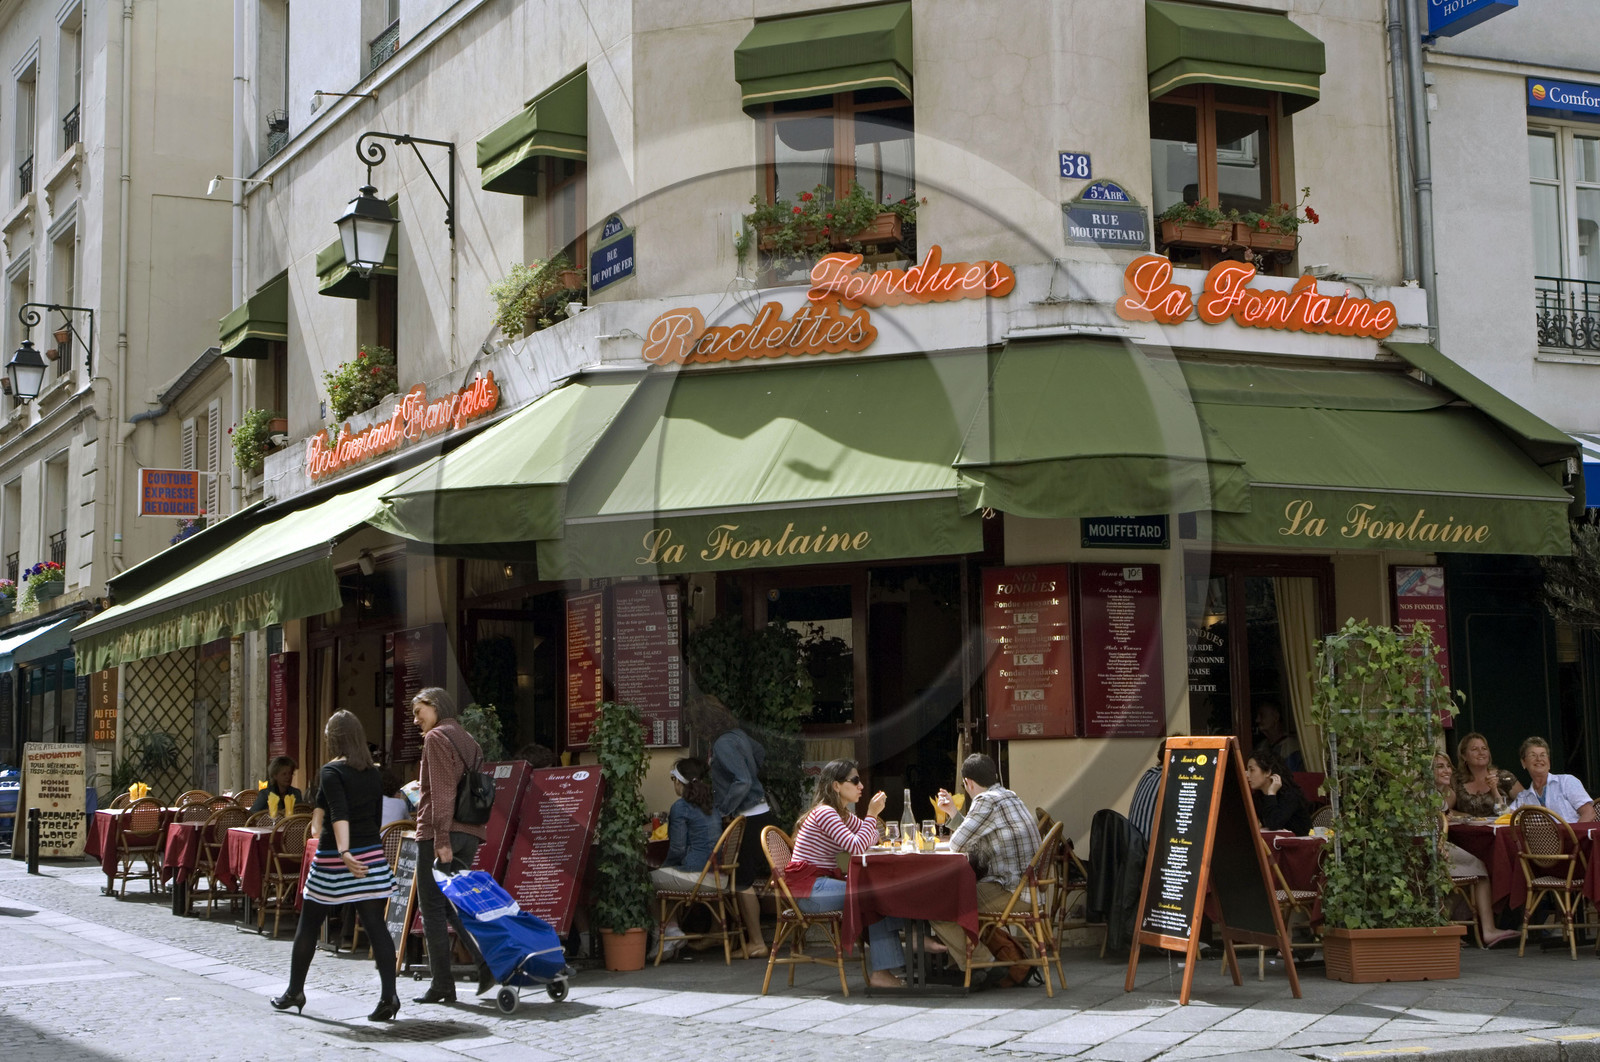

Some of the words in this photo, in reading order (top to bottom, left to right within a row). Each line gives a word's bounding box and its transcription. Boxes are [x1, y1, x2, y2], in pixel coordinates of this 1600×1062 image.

[1062, 154, 1089, 177] 58
[1092, 213, 1119, 225] RUE
[1070, 226, 1145, 241] MOUFFETARD
[606, 247, 618, 262] RUE
[592, 273, 600, 285] DU
[601, 266, 613, 281] POT
[613, 262, 621, 275] DE
[621, 256, 633, 271] FER
[806, 247, 1010, 301] Fondues
[1124, 260, 1193, 316] La
[1207, 266, 1394, 331] Fontaine
[643, 306, 869, 362] Raclettes
[147, 472, 193, 485] COUTURE
[145, 486, 196, 500] EXPRESSE
[144, 501, 196, 514] RETOUCHE
[1278, 499, 1328, 537] La
[1340, 502, 1492, 544] Fontaine
[1089, 523, 1162, 539] MOUFFETARD
[635, 527, 688, 566] La
[700, 521, 873, 562] Fontaine
[996, 581, 1057, 596] FONDUES
[1414, 603, 1444, 611] FONDUES
[94, 709, 103, 719] AU
[104, 709, 118, 719] FEU
[100, 720, 111, 729] DE
[94, 730, 116, 741] BOIS
